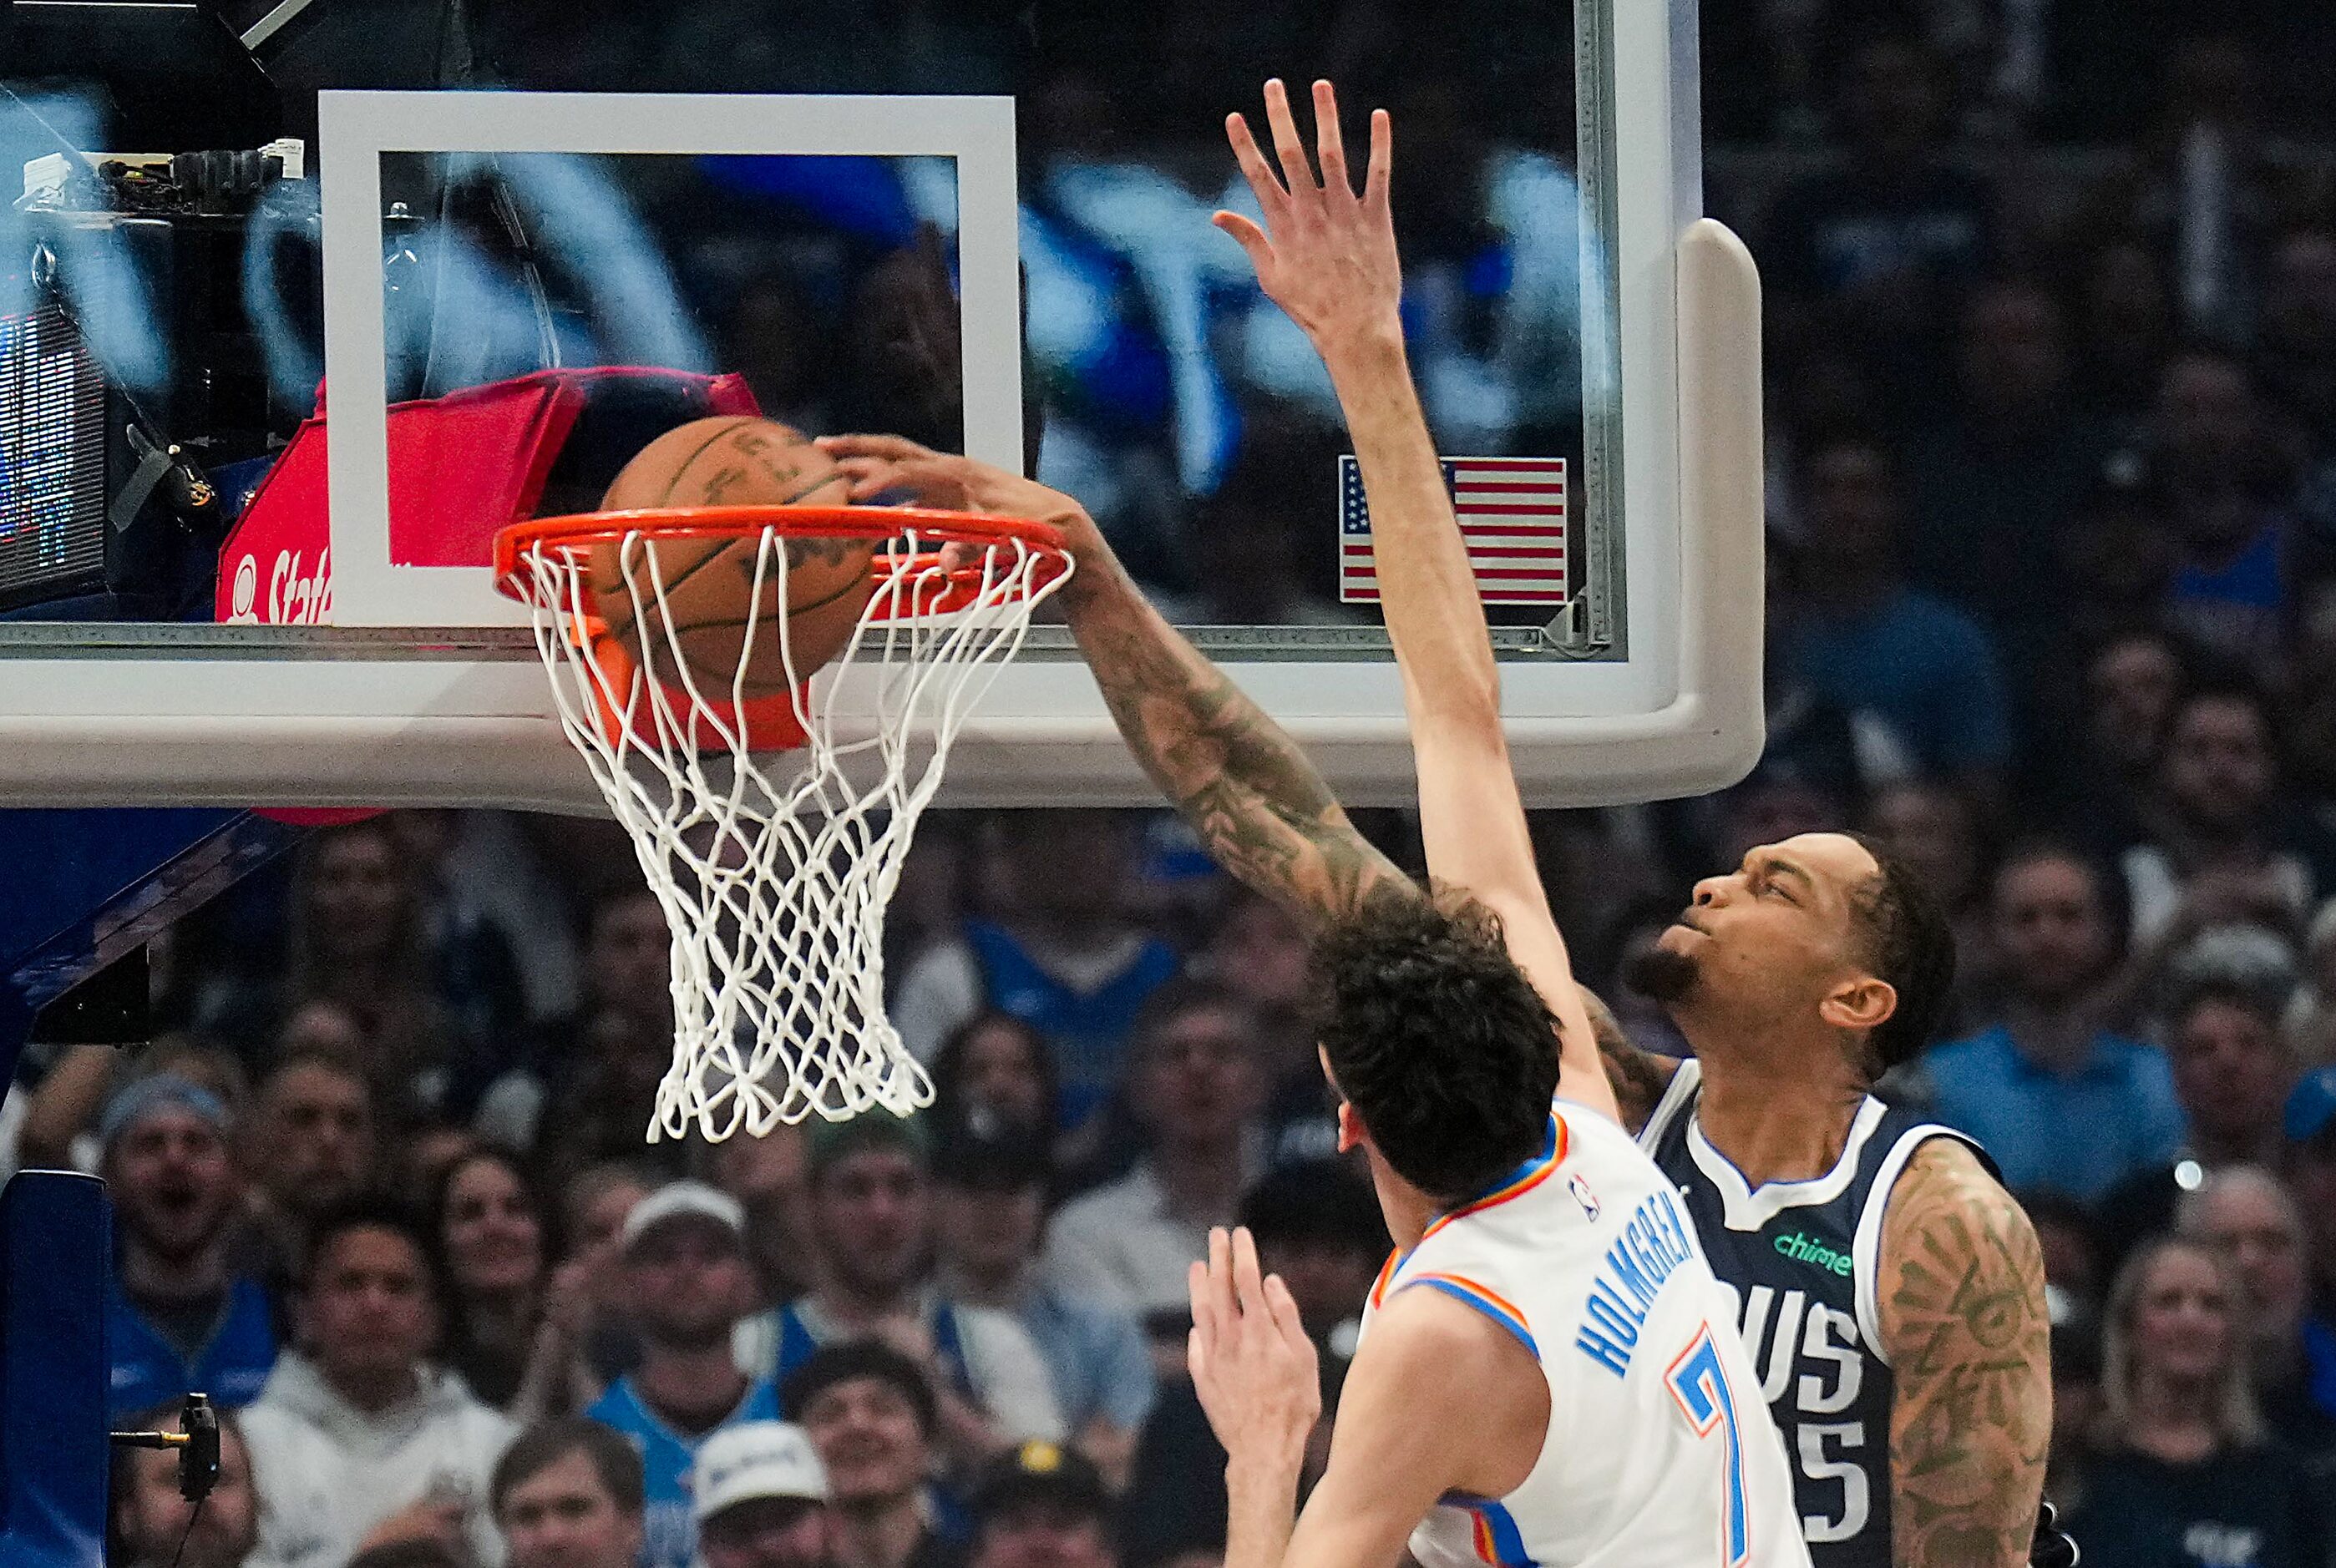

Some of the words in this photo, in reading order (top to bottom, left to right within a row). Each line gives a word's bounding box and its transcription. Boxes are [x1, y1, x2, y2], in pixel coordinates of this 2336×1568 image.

[1575, 1191, 1694, 1379] HOLMGREN
[1774, 1232, 1853, 1277] chime
[1663, 1318, 1751, 1568] 7
